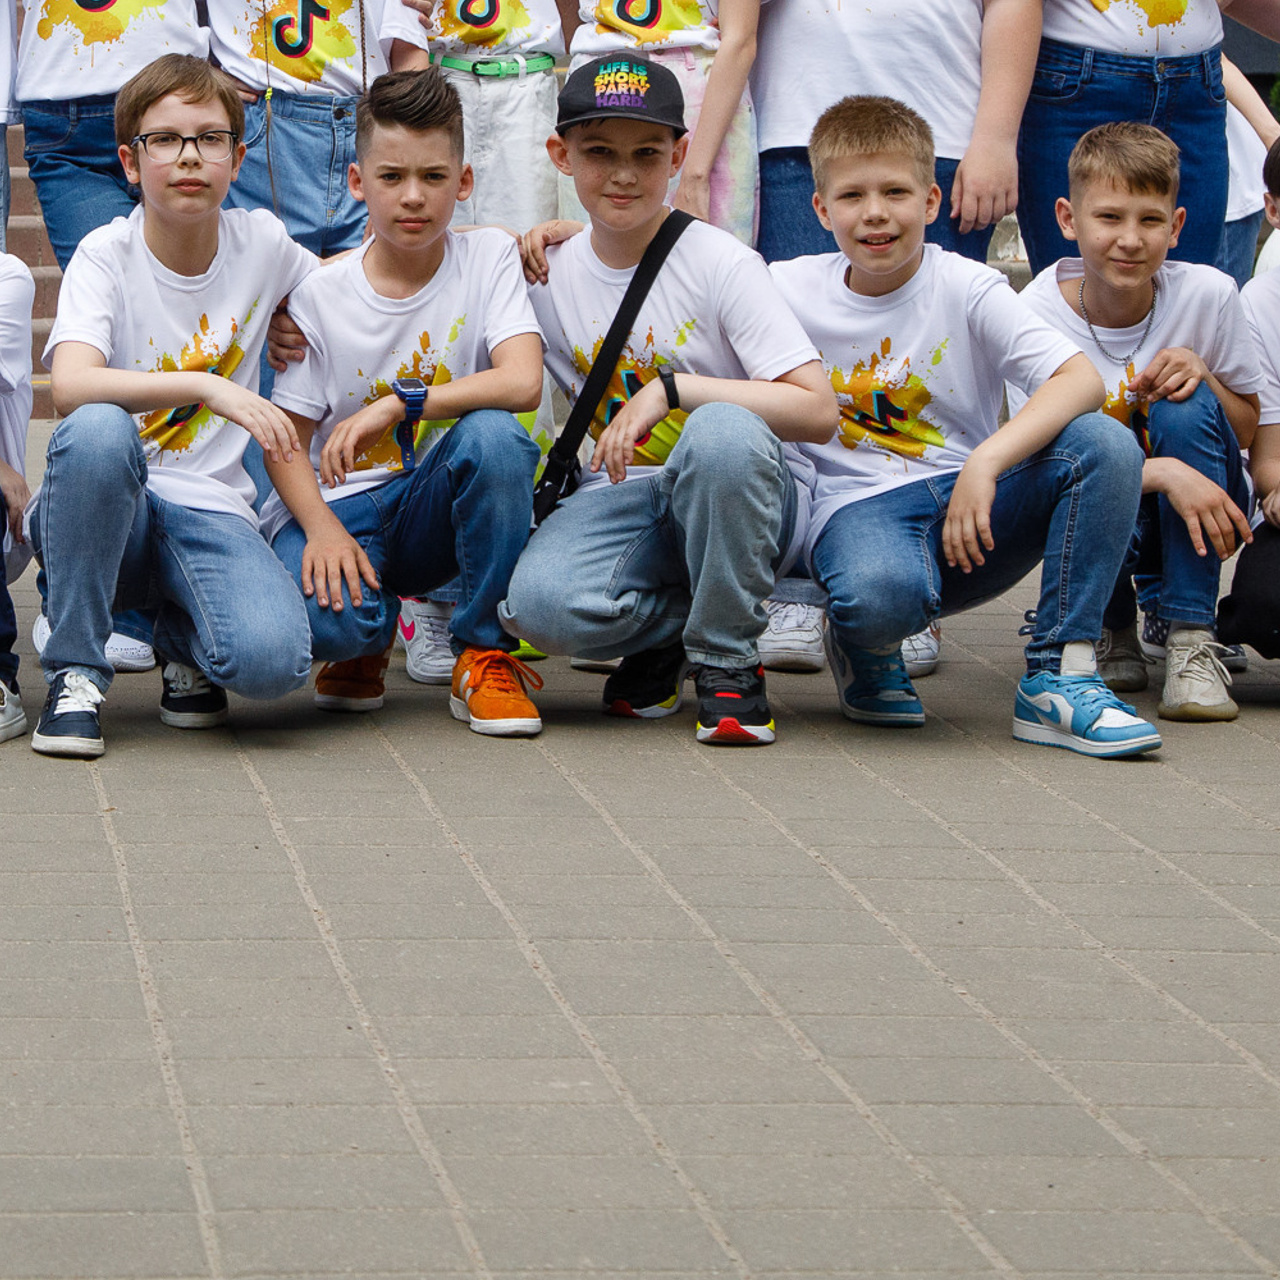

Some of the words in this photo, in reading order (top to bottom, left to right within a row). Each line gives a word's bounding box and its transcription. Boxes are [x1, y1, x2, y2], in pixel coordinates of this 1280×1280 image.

[599, 61, 630, 76] LIFE
[633, 63, 648, 76] IS
[595, 83, 649, 97] PARTY
